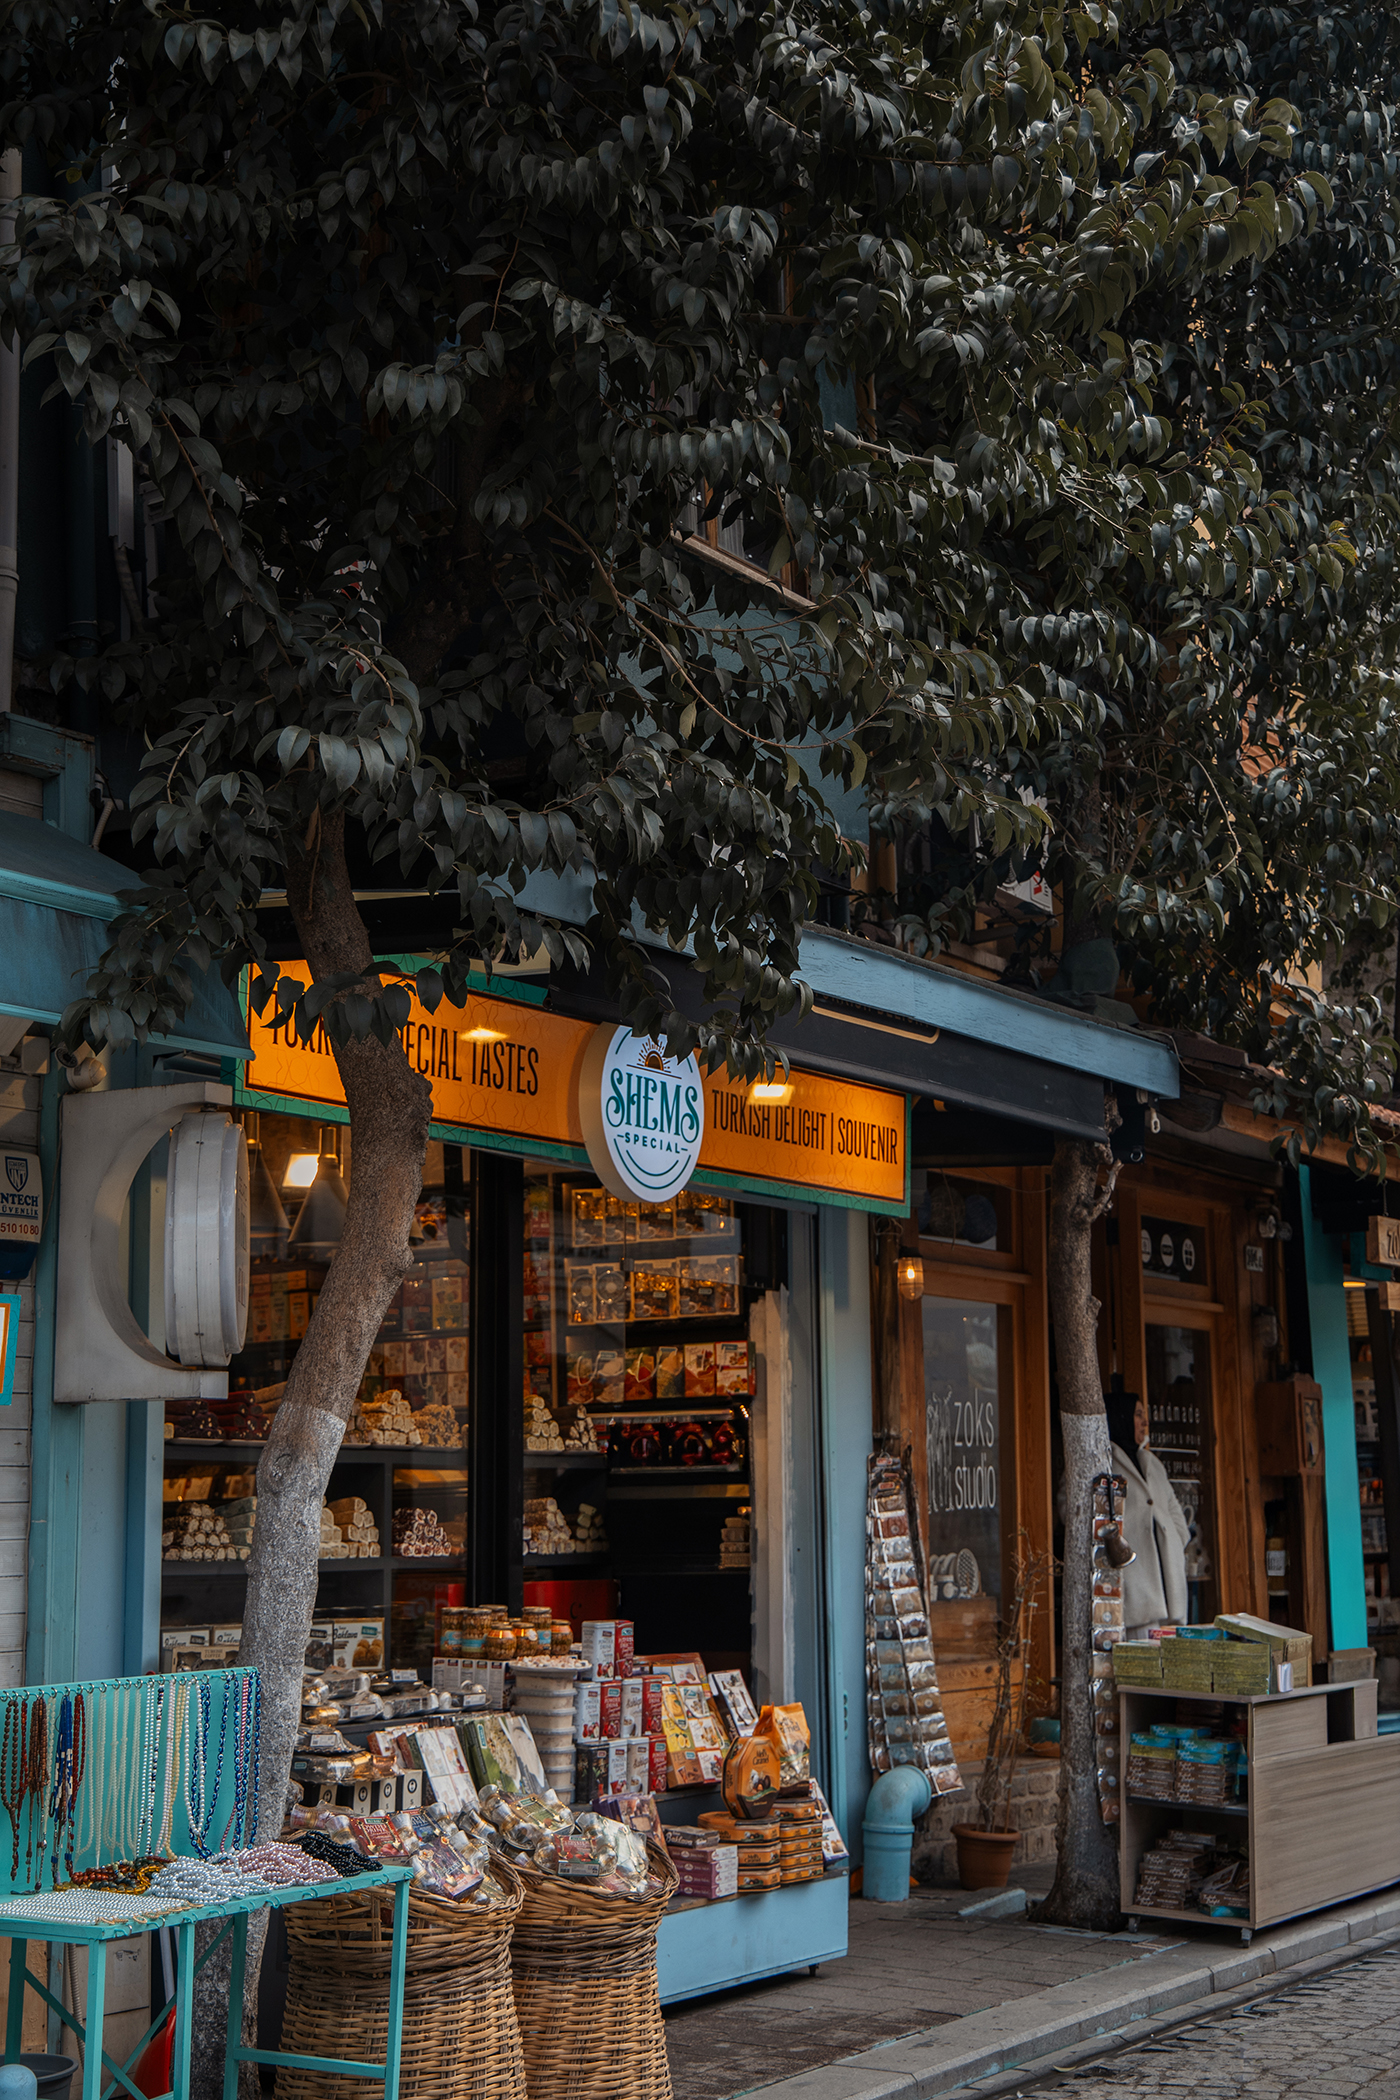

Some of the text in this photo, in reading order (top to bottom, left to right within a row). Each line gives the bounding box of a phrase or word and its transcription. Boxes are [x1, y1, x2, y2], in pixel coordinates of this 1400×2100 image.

[471, 1037, 539, 1096] TASTES
[606, 1068, 700, 1144] SHEMS
[711, 1089, 771, 1140] TURKISH
[775, 1105, 826, 1151] DELIGHT
[838, 1117, 898, 1165] SOUVENIR
[624, 1131, 680, 1155] SPECIAL
[19, 1224, 28, 1234] 10
[30, 1225, 39, 1235] 80
[954, 1388, 995, 1447] zoks
[954, 1455, 997, 1510] studio
